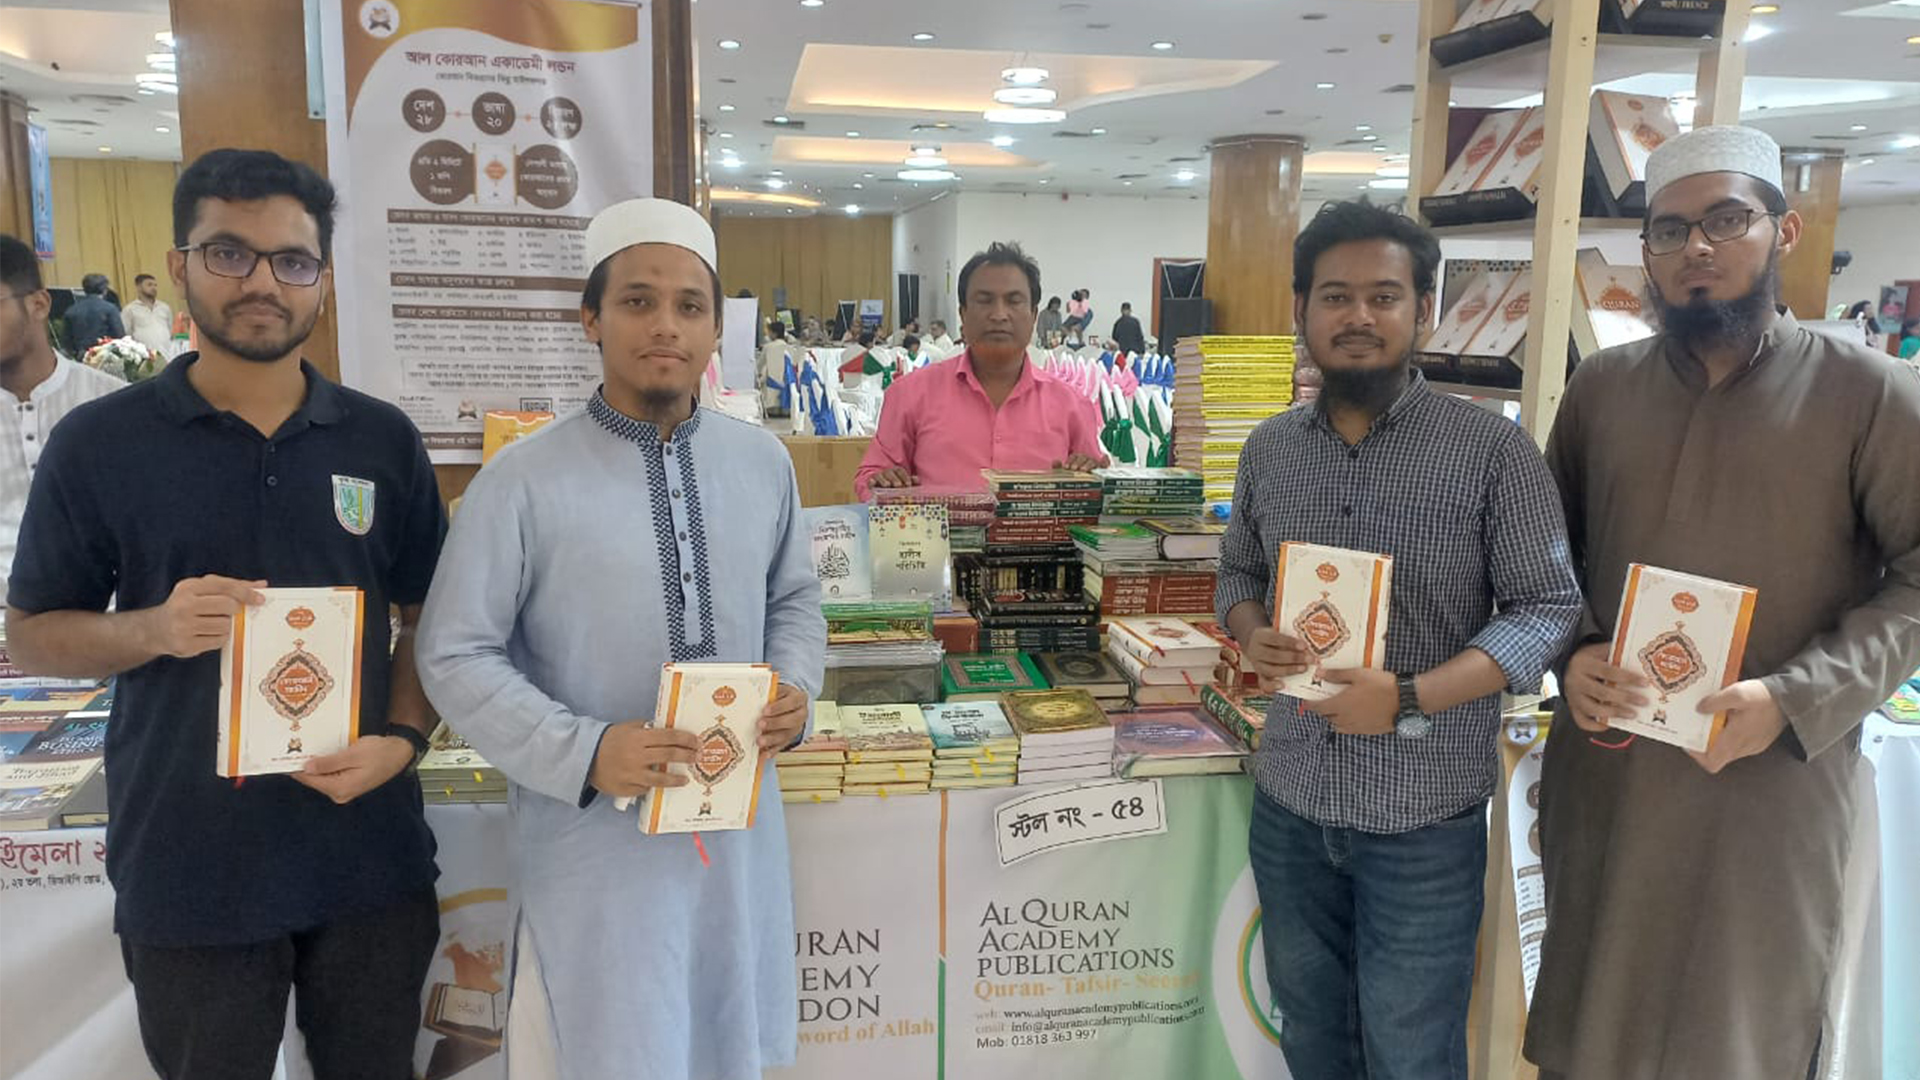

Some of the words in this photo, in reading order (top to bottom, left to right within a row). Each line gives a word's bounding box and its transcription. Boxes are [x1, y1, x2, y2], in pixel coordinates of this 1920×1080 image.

[405, 51, 431, 66] আল
[435, 52, 487, 67] কোরআন
[547, 60, 577, 74] লন্ডন
[413, 101, 435, 112] দেশ
[482, 103, 506, 115] ভাষা
[416, 113, 433, 125] ২৮
[486, 117, 503, 129] ২০
[1008, 812, 1050, 838] স্টল
[1054, 806, 1087, 828] নং
[1111, 796, 1145, 821] ৫৪
[979, 901, 1018, 928] AL
[1021, 898, 1131, 928] QURAN
[978, 927, 1121, 953] ACADEMY
[977, 948, 1175, 978] PUBLICATIONS
[856, 1022, 877, 1041] of
[881, 1016, 935, 1039] Allah
[976, 1035, 1008, 1049] Mob:
[1011, 1031, 1049, 1046] 01818
[1051, 1029, 1073, 1043] 363
[1076, 1027, 1097, 1041] 997
